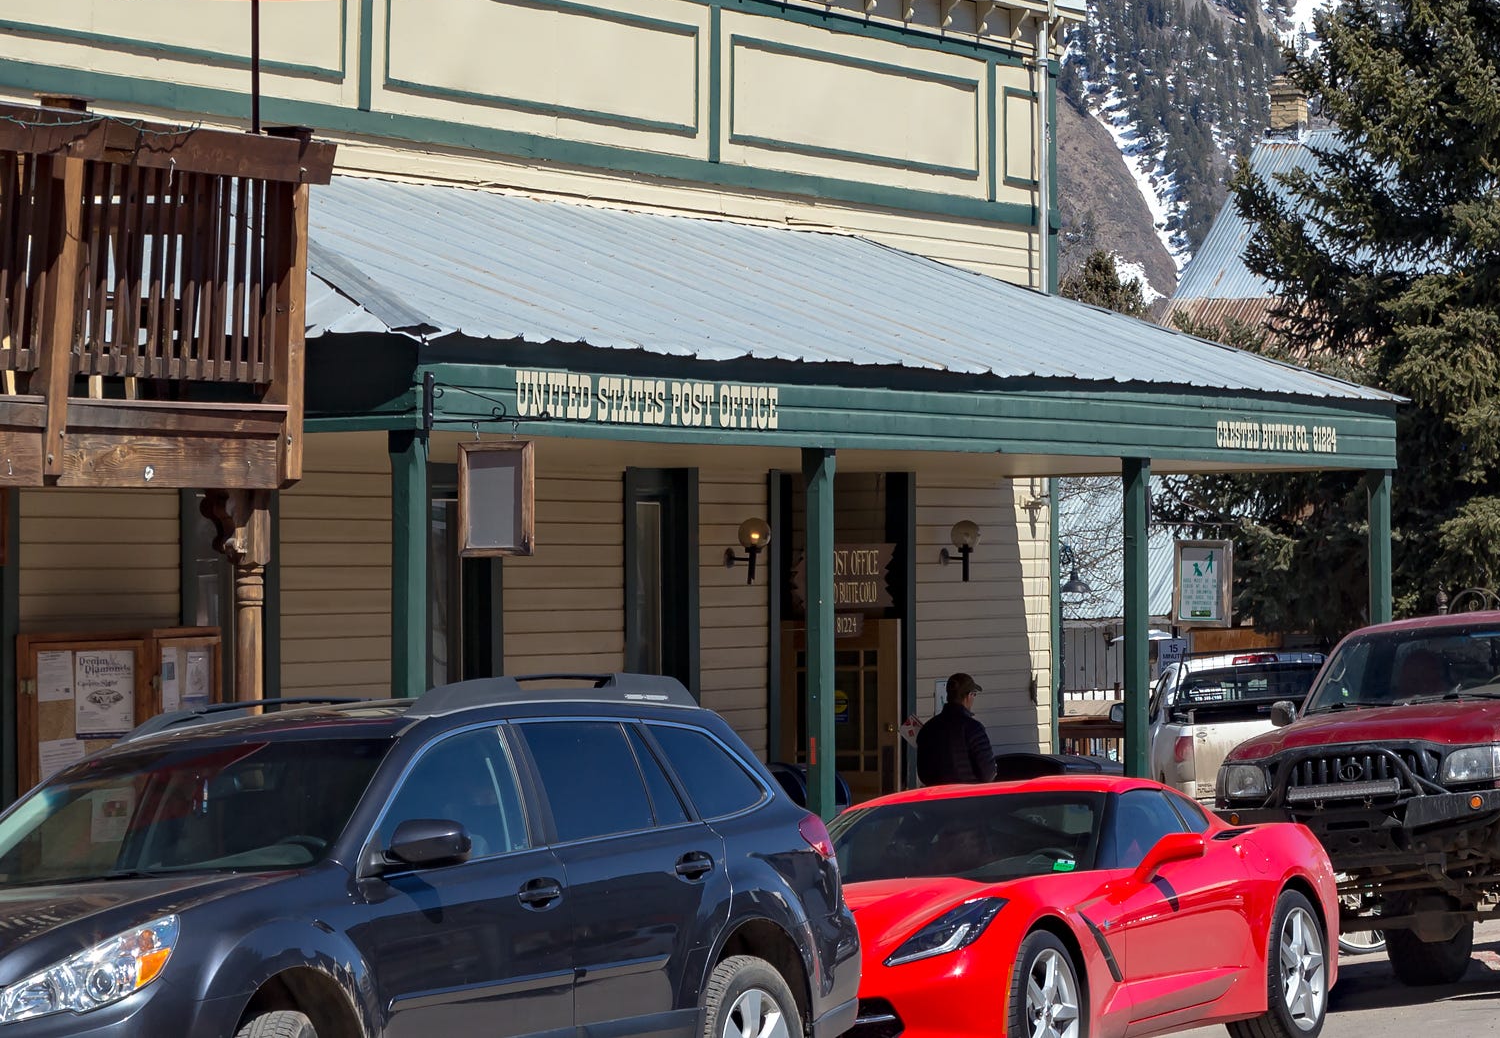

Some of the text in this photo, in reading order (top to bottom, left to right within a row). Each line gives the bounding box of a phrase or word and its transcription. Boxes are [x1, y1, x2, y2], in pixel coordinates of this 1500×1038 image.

[515, 370, 778, 430] UNITED STATES POST OFFICE
[1216, 421, 1337, 453] CRESTED BUTTE CO. 81224
[833, 550, 880, 576] OST OFFICE
[840, 582, 859, 604] BUTTE
[836, 617, 857, 633] 81224
[1169, 644, 1178, 653] 15
